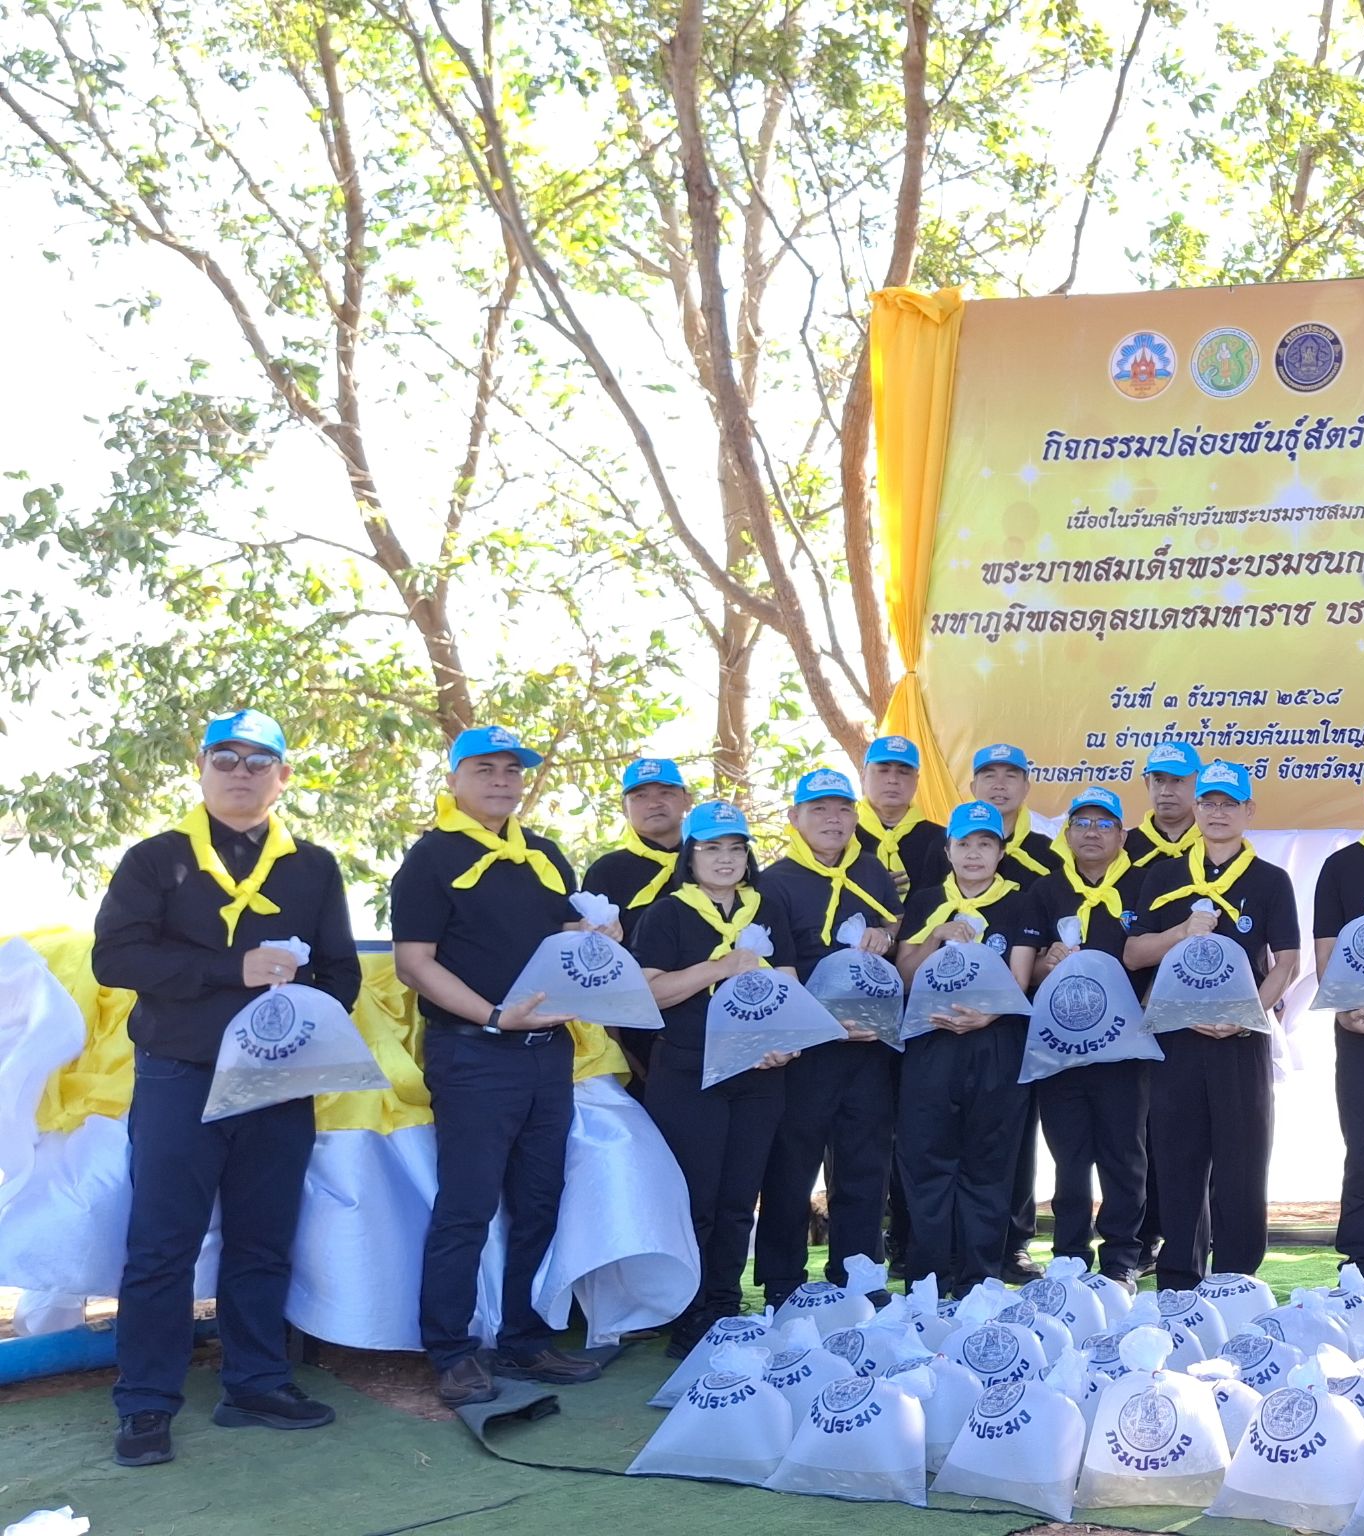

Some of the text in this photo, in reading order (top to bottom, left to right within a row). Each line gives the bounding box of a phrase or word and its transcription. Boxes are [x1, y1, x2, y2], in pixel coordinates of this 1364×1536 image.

[931, 601, 1316, 643] มหาภูมิพลอดุลยเดชมหาราช
[1110, 682, 1343, 709] วันที่ ๓ ธันวาคม ๒๕๖๘
[1086, 733, 1106, 748] ณ
[1026, 760, 1134, 782] ำบลคำชะอี
[925, 962, 980, 993] กรมประมง
[1172, 963, 1235, 990] กรมประมง
[723, 984, 790, 1021] กรมประมง
[235, 1020, 316, 1061] กรมประมง
[1038, 1015, 1126, 1055] กรมประมง
[1105, 1430, 1193, 1471] กรมประมง
